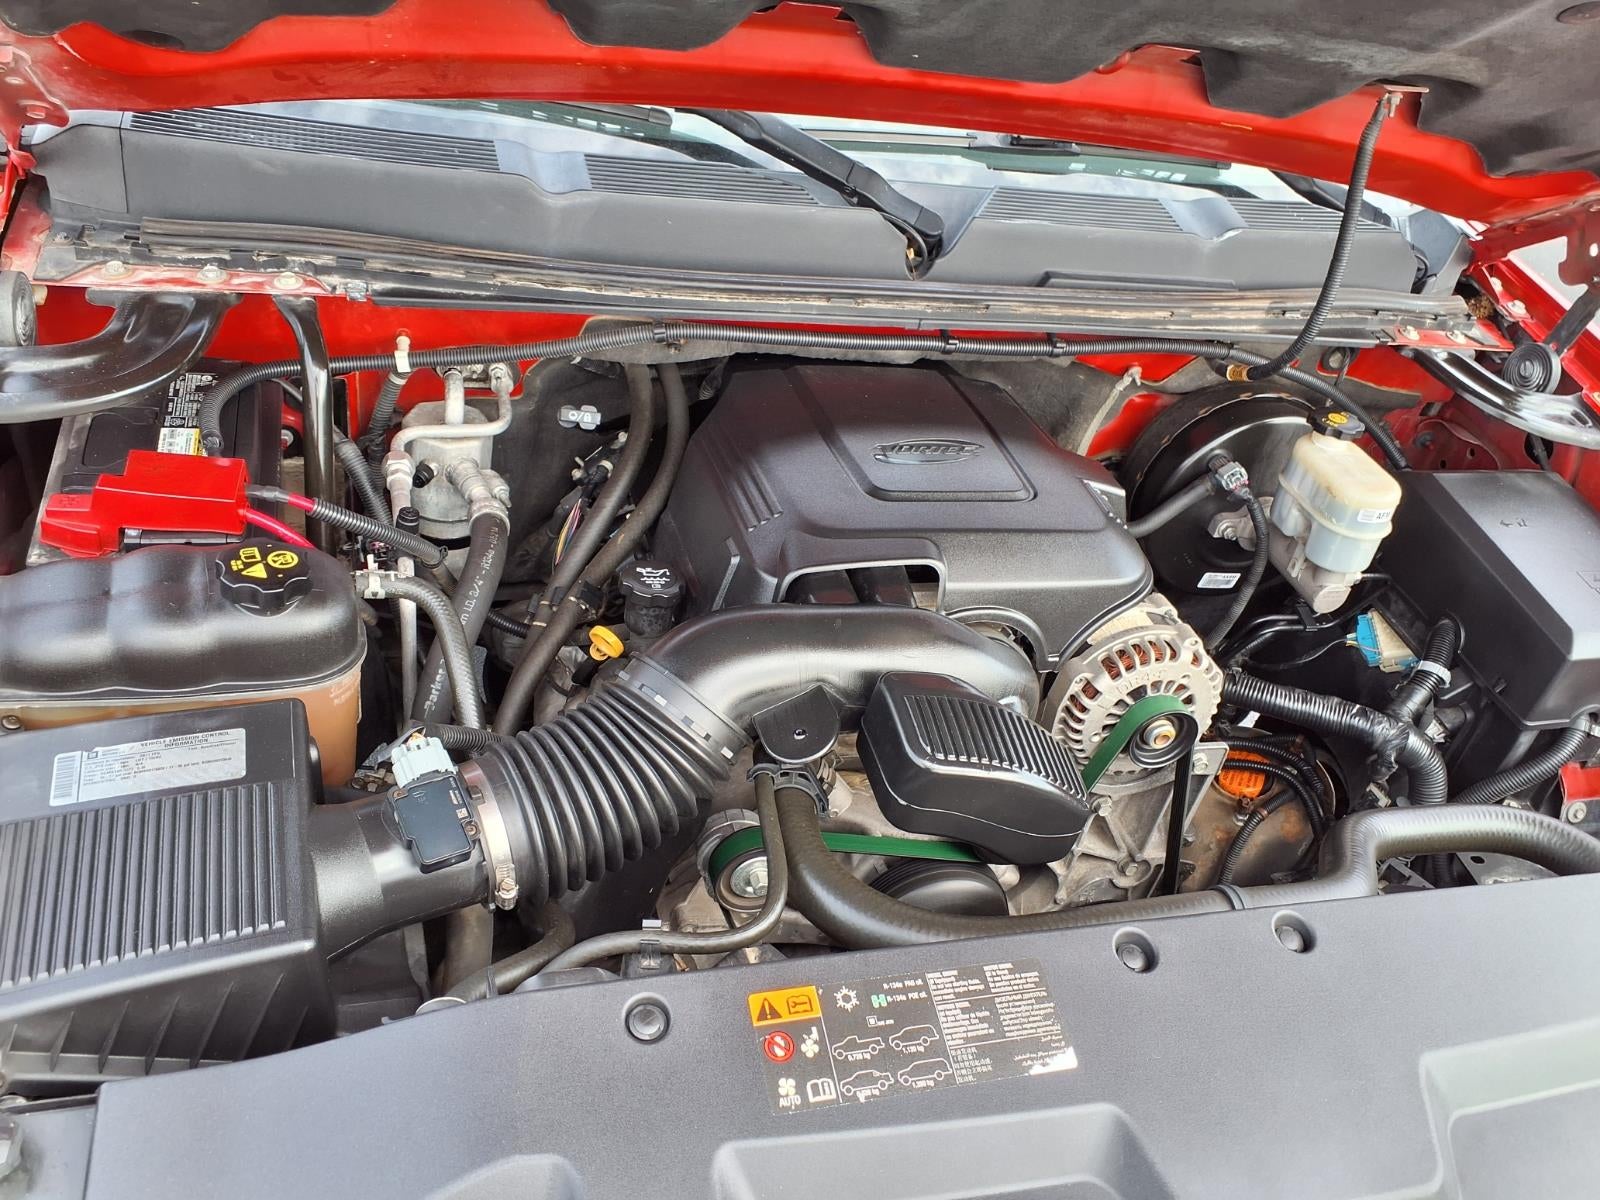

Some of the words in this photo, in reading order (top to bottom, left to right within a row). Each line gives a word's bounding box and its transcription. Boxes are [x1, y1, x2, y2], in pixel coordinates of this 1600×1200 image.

[140, 739, 166, 748] VEHICLE
[168, 735, 200, 744] EMISSION
[201, 731, 230, 740] CONTROL
[163, 738, 209, 749] INFORMATION
[779, 1094, 802, 1109] AUTO
